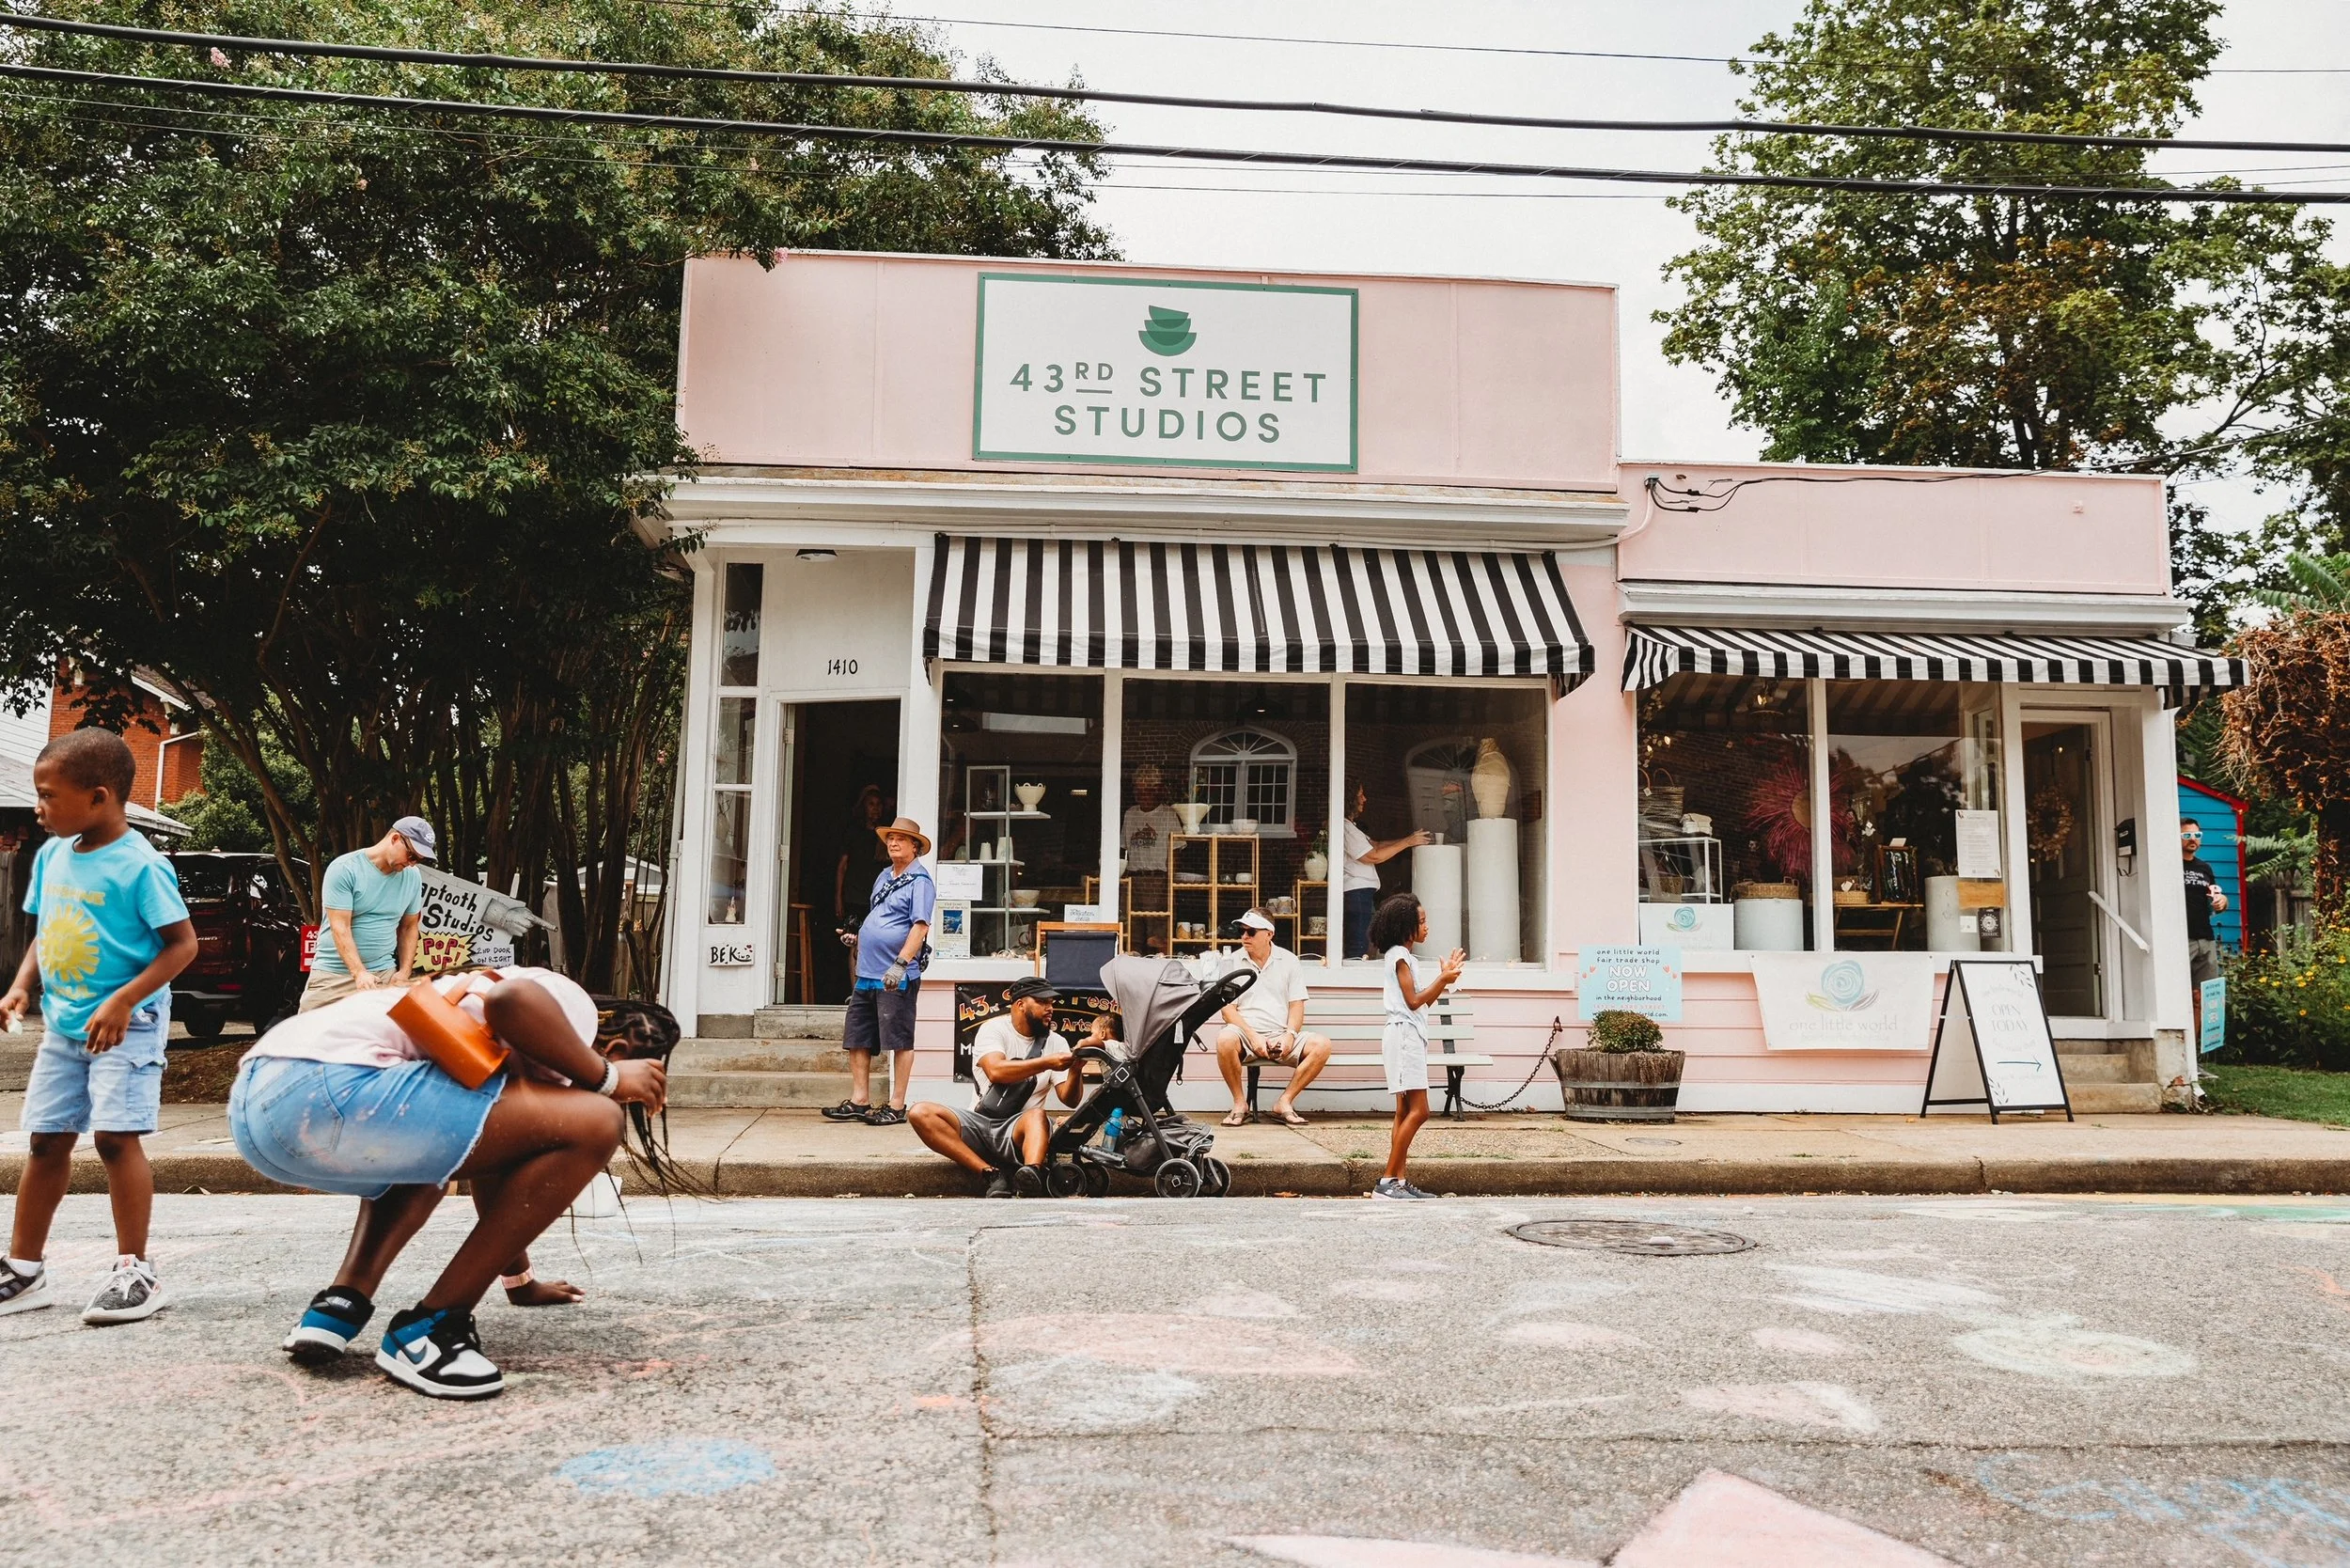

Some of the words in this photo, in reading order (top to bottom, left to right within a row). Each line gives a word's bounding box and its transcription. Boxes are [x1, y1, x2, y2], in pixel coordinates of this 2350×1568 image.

[1010, 362, 1114, 393] 43RD
[1139, 366, 1326, 403] STREET
[1055, 404, 1280, 444] STUDIOS
[827, 659, 858, 676] 1410
[421, 902, 494, 942] Studios
[306, 930, 319, 940] 43
[477, 947, 491, 955] 2ND
[710, 946, 726, 964] BE
[489, 955, 511, 964] RIGHT
[1641, 957, 1660, 965] shop
[1608, 964, 1648, 978] NOW
[1606, 979, 1652, 993] OPEN
[1617, 995, 1662, 1003] neighborhood
[959, 995, 1000, 1022] 43rd
[1991, 1003, 2022, 1016] OPEN
[1060, 1017, 1092, 1033] Arts
[1789, 1021, 1817, 1031] one
[1820, 1013, 1854, 1031] little
[1856, 1014, 1898, 1031] world
[1991, 1019, 2029, 1031] TODAY
[332, 1296, 352, 1309] NIKE
